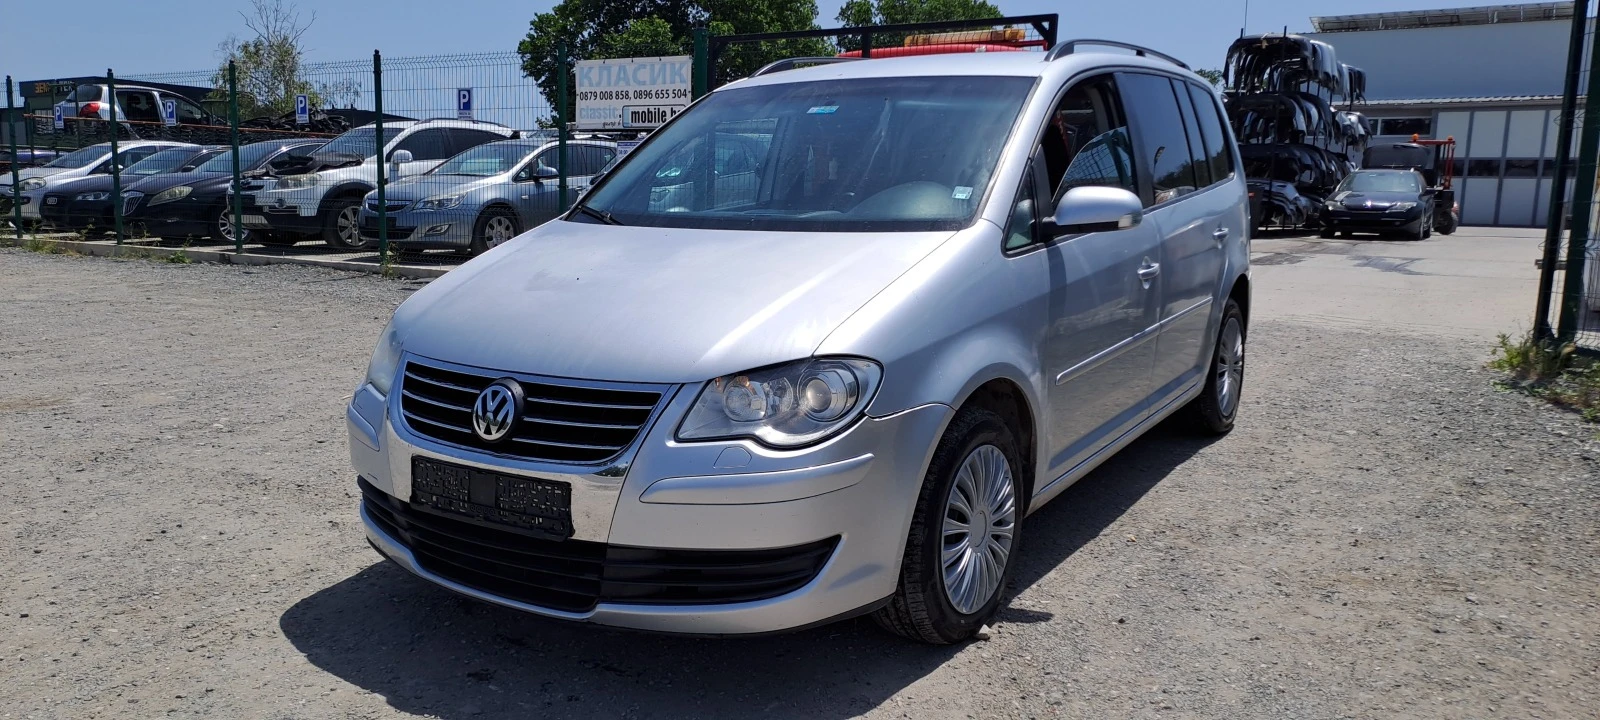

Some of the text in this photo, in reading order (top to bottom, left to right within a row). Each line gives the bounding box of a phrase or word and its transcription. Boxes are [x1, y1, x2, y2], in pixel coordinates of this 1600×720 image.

[579, 63, 687, 87] КЛАСИК
[460, 91, 469, 110] P
[579, 88, 687, 101] 0879 008 858, 0896 655 504
[167, 102, 173, 118] P
[298, 97, 305, 113] P
